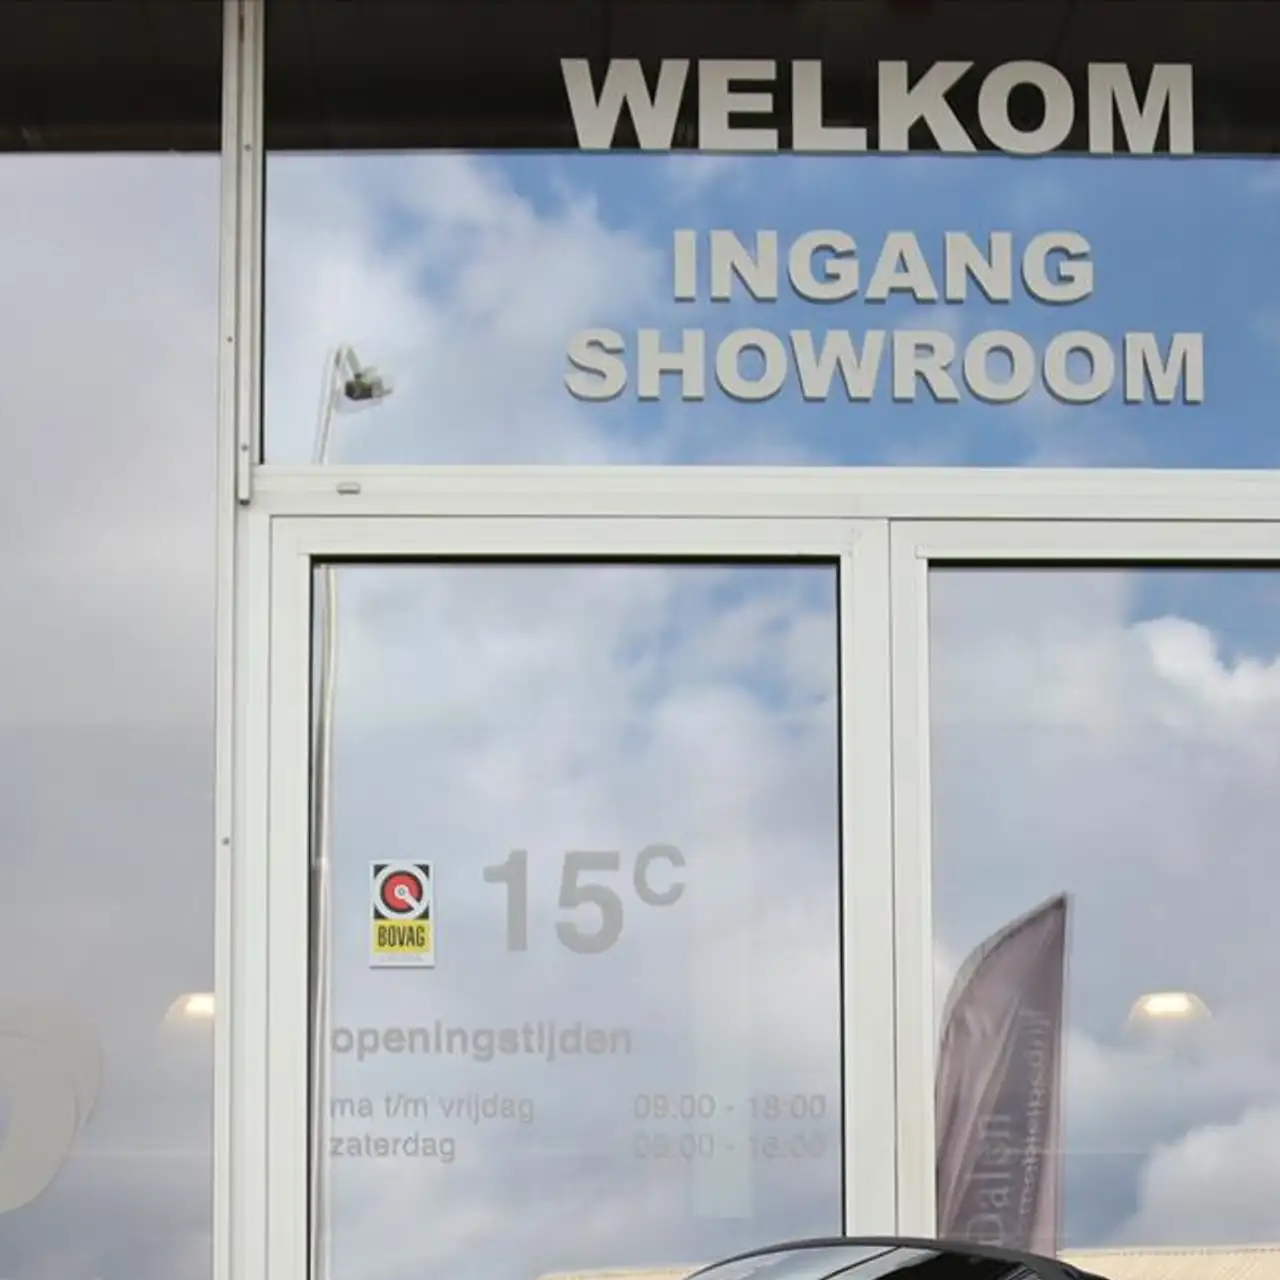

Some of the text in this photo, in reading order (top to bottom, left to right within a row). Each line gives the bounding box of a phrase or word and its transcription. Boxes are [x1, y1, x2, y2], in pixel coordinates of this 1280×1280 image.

[560, 58, 1194, 155] WELKOM
[673, 229, 1094, 303] INGANG
[564, 328, 1204, 404] SHOWROOM
[378, 925, 426, 947] BOVAG
[330, 1020, 632, 1060] openingstijden
[329, 1097, 373, 1119] ma
[383, 1093, 428, 1119] t/m
[438, 1092, 534, 1125] vrijdag
[329, 1131, 456, 1163] zaterdag
